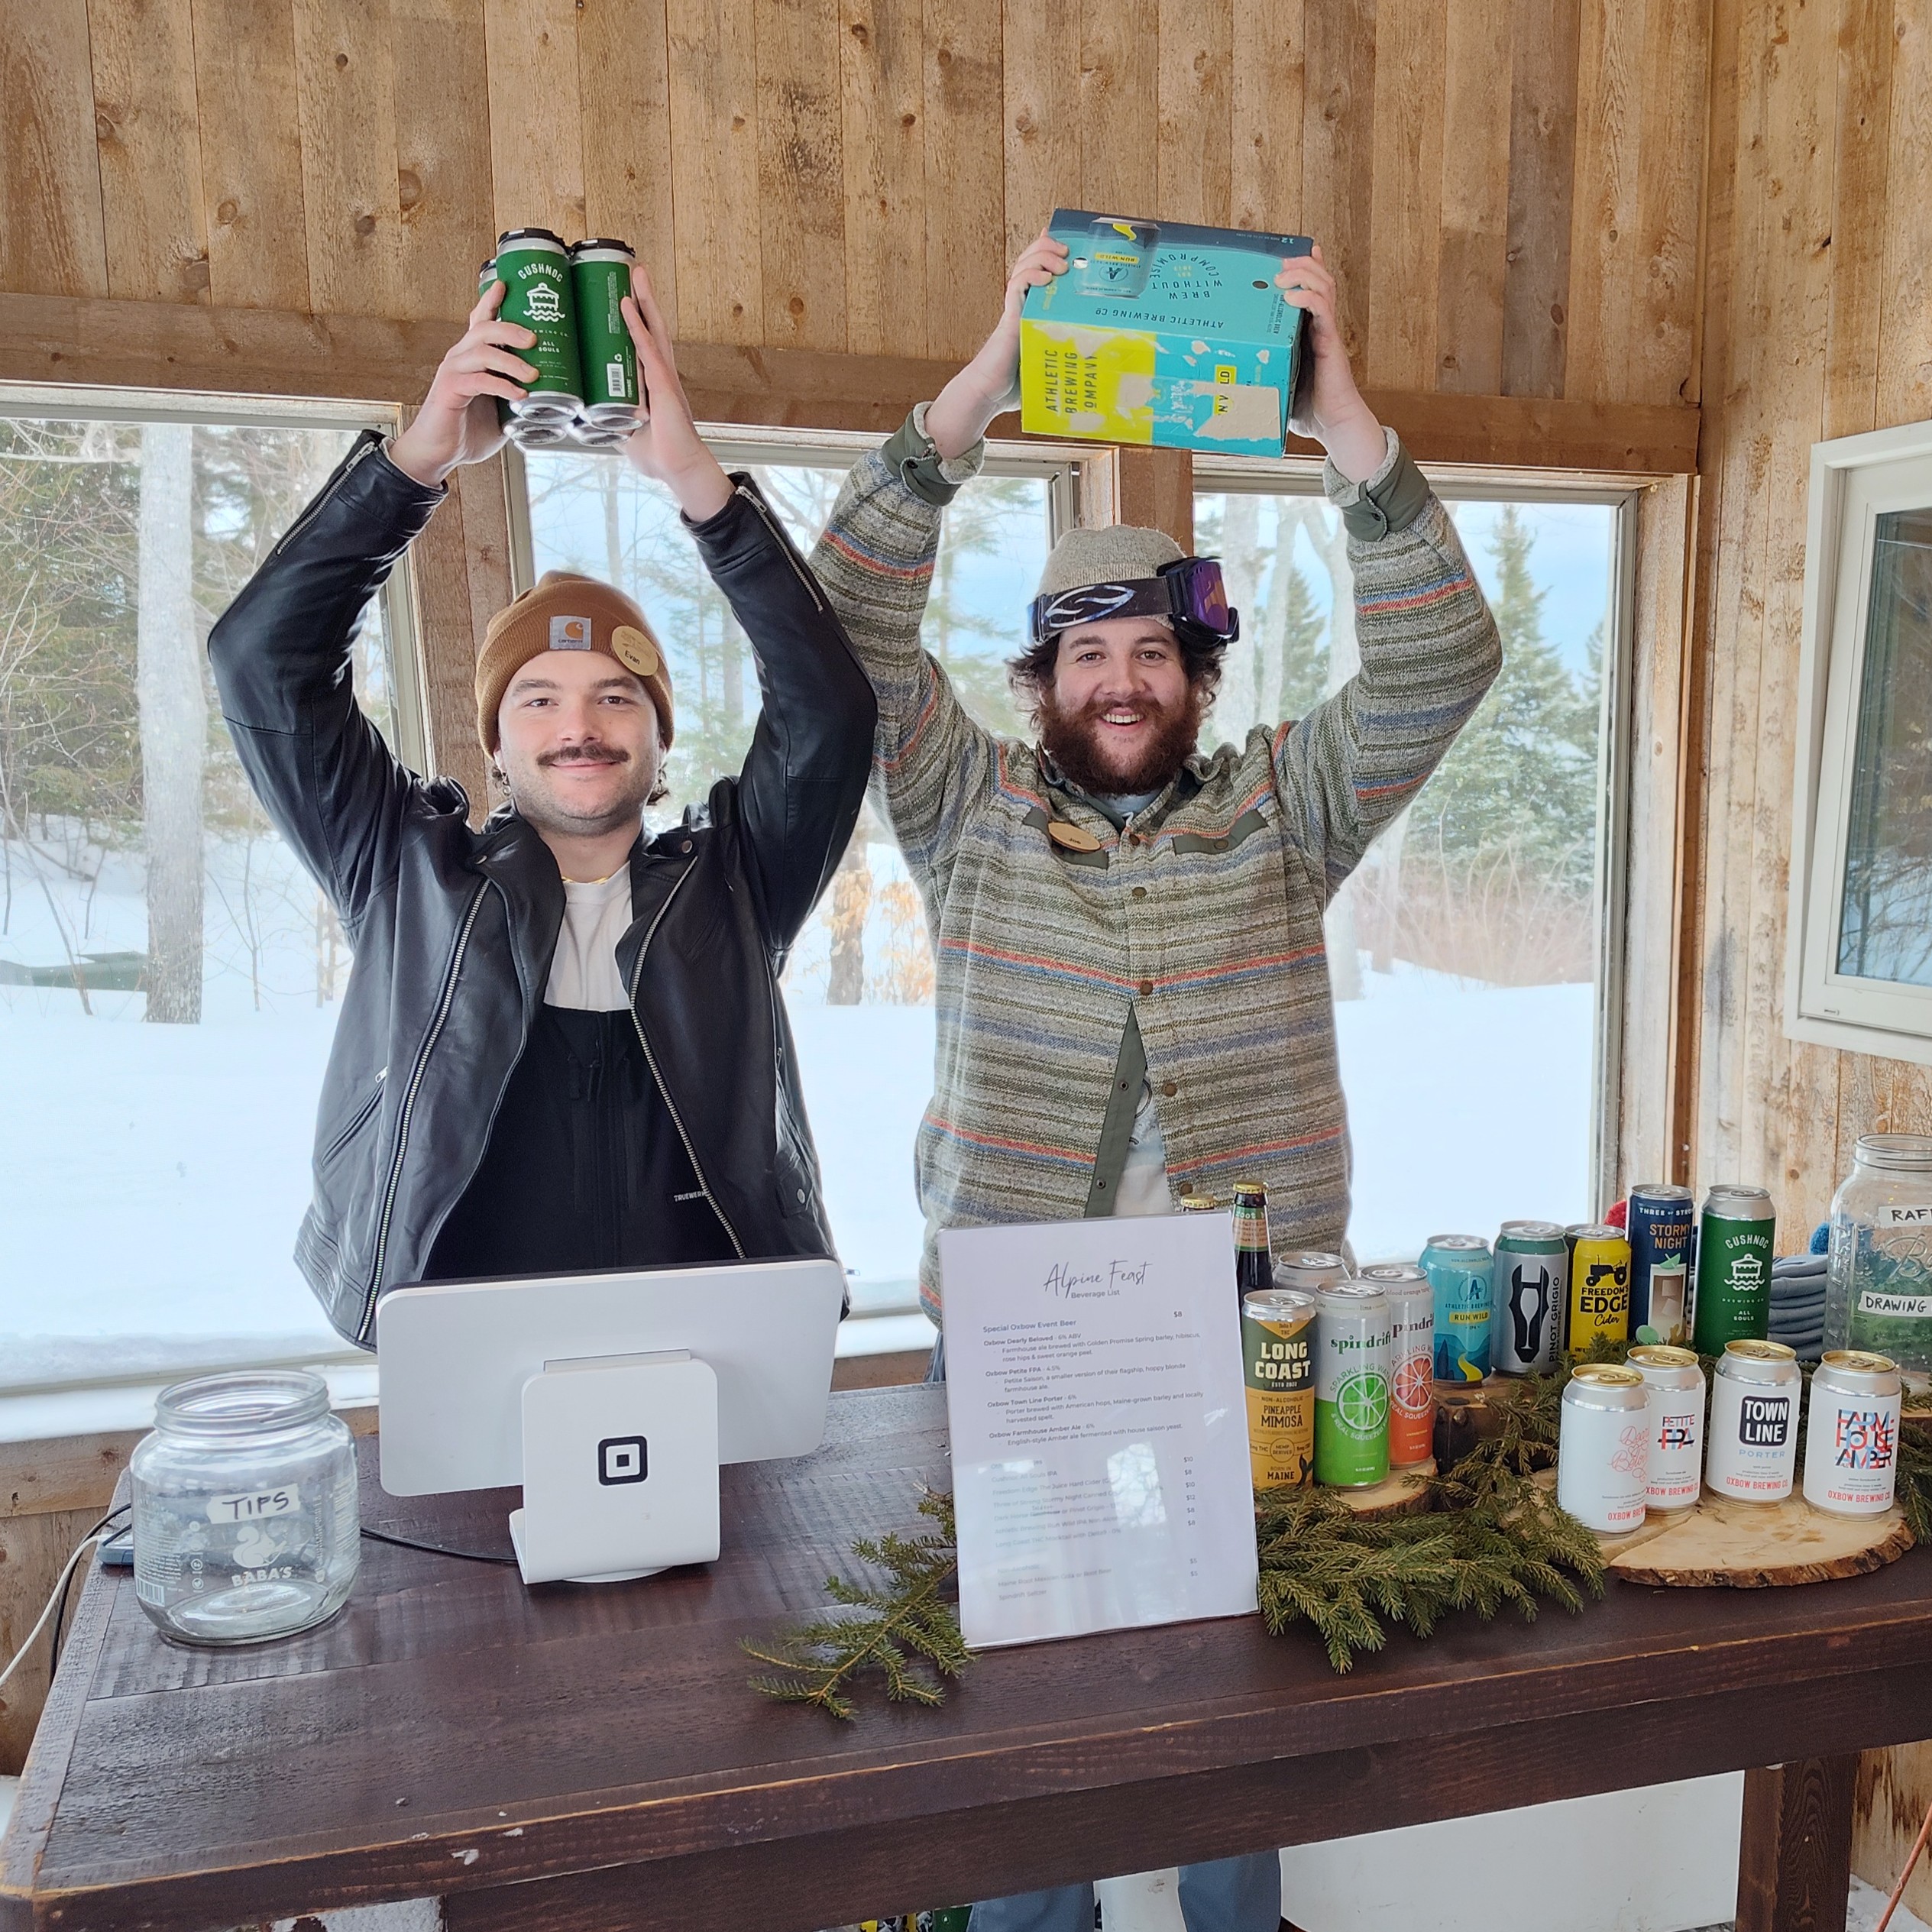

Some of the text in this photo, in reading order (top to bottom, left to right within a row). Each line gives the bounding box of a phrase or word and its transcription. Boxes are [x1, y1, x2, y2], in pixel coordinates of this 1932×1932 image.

[1149, 253, 1219, 279] COMPROMISE
[518, 263, 563, 283] CUSHNOC
[1151, 280, 1222, 290] WITHOUT
[1168, 290, 1210, 299] BREW
[1112, 309, 1224, 328] ATHLETIC BREWING
[1045, 350, 1058, 412] ATHLETIC
[1065, 352, 1077, 413] BREWING
[1084, 355, 1097, 413] OMPANY
[624, 649, 641, 665] Evan
[1639, 1207, 1665, 1215] THREE
[1891, 1209, 1932, 1222] RAF
[1649, 1223, 1691, 1236] STORMY
[1655, 1237, 1687, 1249] NIGHT
[1725, 1235, 1769, 1249] CUSHNOC
[1043, 1260, 1154, 1299] Alpine Feast
[1071, 1289, 1120, 1299] Beverage List
[1580, 1293, 1628, 1313] EDGE
[1866, 1296, 1927, 1312] DRAWING
[1173, 1310, 1183, 1319] $8
[1472, 1312, 1488, 1321] WILD
[1549, 1277, 1560, 1362] PINOT GRIGIO
[1594, 1314, 1620, 1326] Cider
[983, 1319, 1076, 1334] Special Oxbow Event Beer
[984, 1338, 1006, 1347] Oxbow
[1007, 1336, 1027, 1346] Dearly
[1029, 1335, 1053, 1343] Beloved
[1002, 1345, 1037, 1354] Farmhouse
[1110, 1337, 1134, 1345] Promise
[1135, 1335, 1154, 1345] Spring
[1156, 1334, 1175, 1343] barley,
[1331, 1331, 1391, 1354] spindrift
[1260, 1341, 1307, 1360] LONG
[985, 1369, 1008, 1377] Oxbow
[1255, 1360, 1311, 1380] COAST
[1330, 1363, 1375, 1393] SPARKLING
[987, 1400, 1010, 1408] Oxbow
[1044, 1395, 1063, 1403] Porter
[1264, 1405, 1301, 1415] PINEAPPLE
[1745, 1400, 1788, 1421] TOWN
[1261, 1415, 1303, 1428] MIMOSA
[1334, 1419, 1348, 1435] REAL
[1662, 1414, 1695, 1427] PETITE
[989, 1431, 1011, 1439] Oxbow
[1013, 1427, 1048, 1437] Farmhouse
[1746, 1422, 1784, 1442] LINE
[1739, 1449, 1785, 1458] PORTER
[1267, 1471, 1295, 1480] MAINE
[1646, 1487, 1666, 1496] XBOW
[1668, 1484, 1693, 1496] BREWING
[1727, 1477, 1781, 1490] OXBOW BREWING
[1828, 1490, 1884, 1503] OXBOW BREWING
[222, 1491, 289, 1519] TIPS
[1608, 1511, 1631, 1520] OXBOW
[231, 1566, 293, 1587] BABA'S
